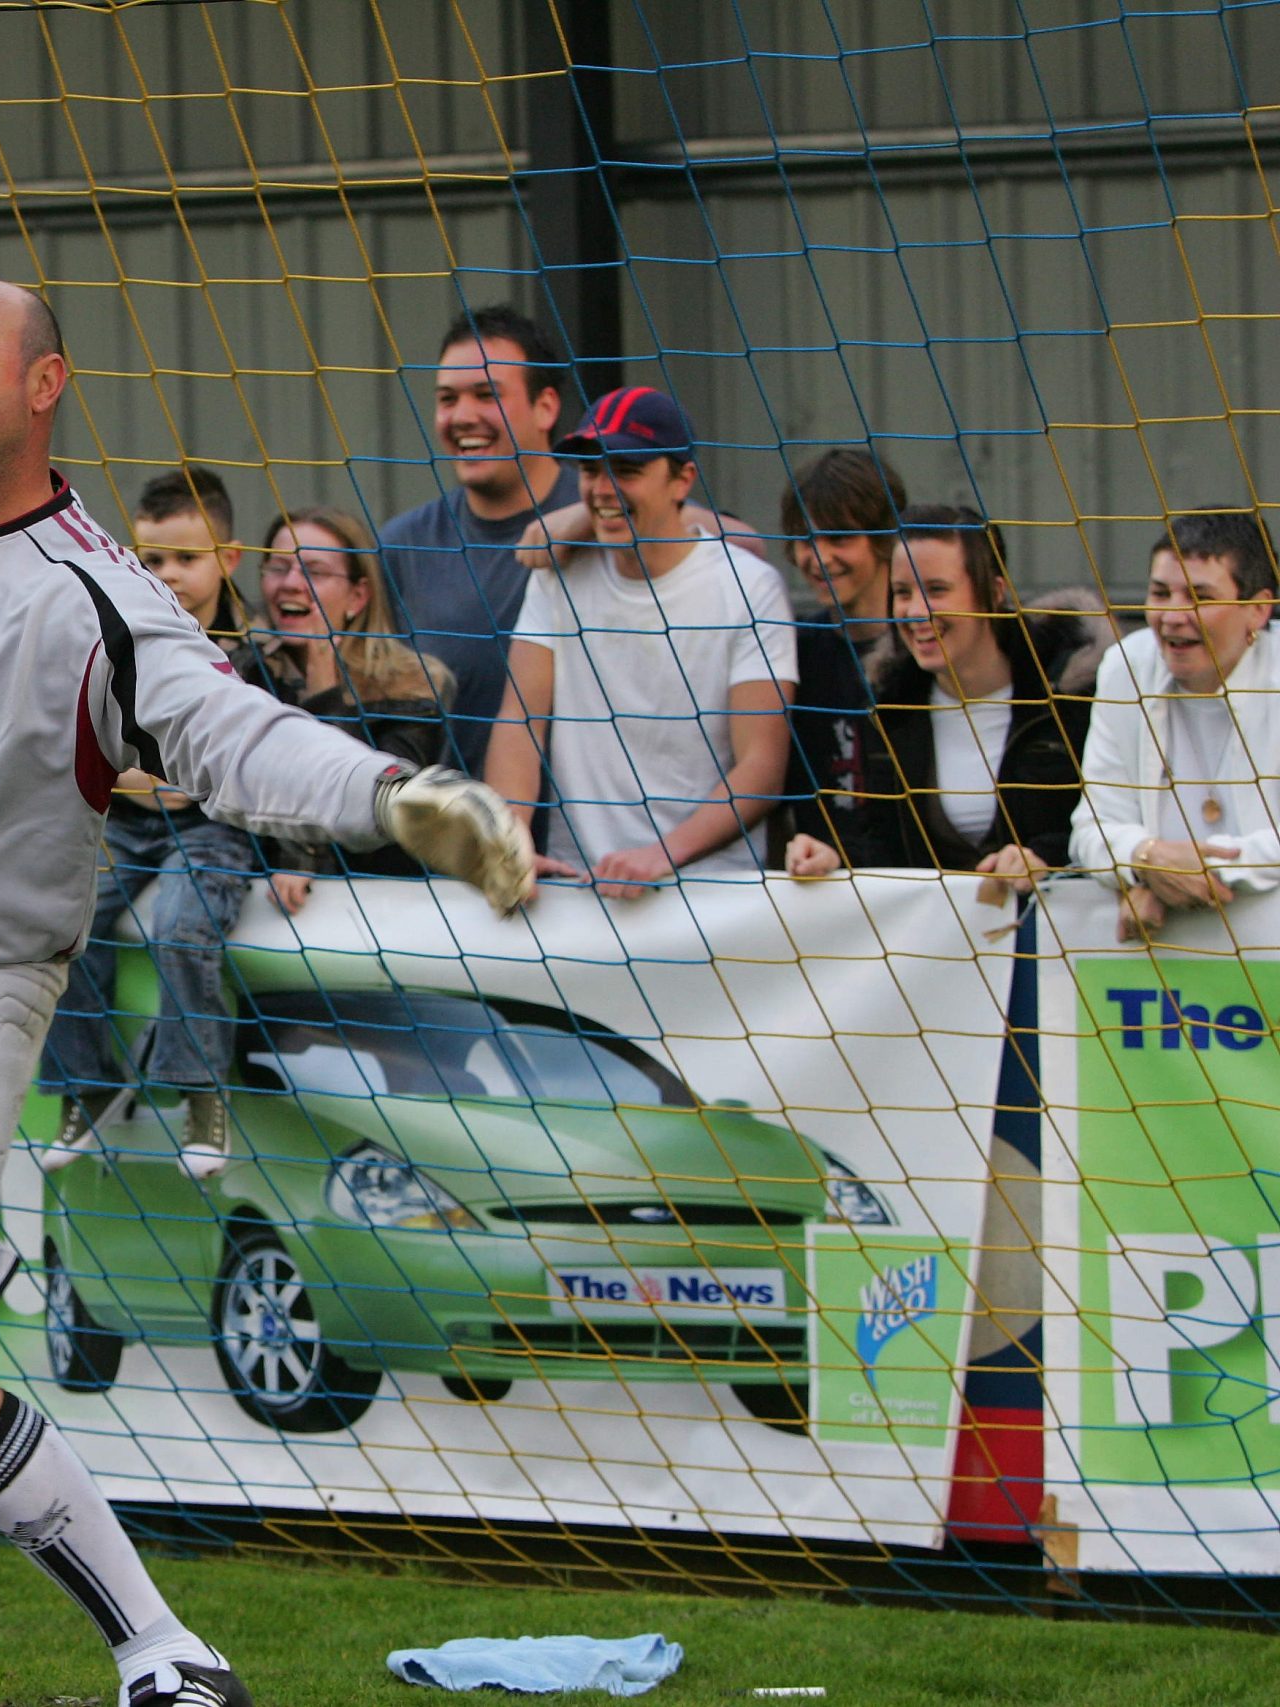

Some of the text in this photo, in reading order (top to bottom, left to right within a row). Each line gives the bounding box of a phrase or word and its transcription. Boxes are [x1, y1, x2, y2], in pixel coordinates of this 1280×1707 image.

[1106, 987, 1264, 1051] The
[559, 1274, 775, 1304] The News
[860, 1255, 931, 1328] WASH
